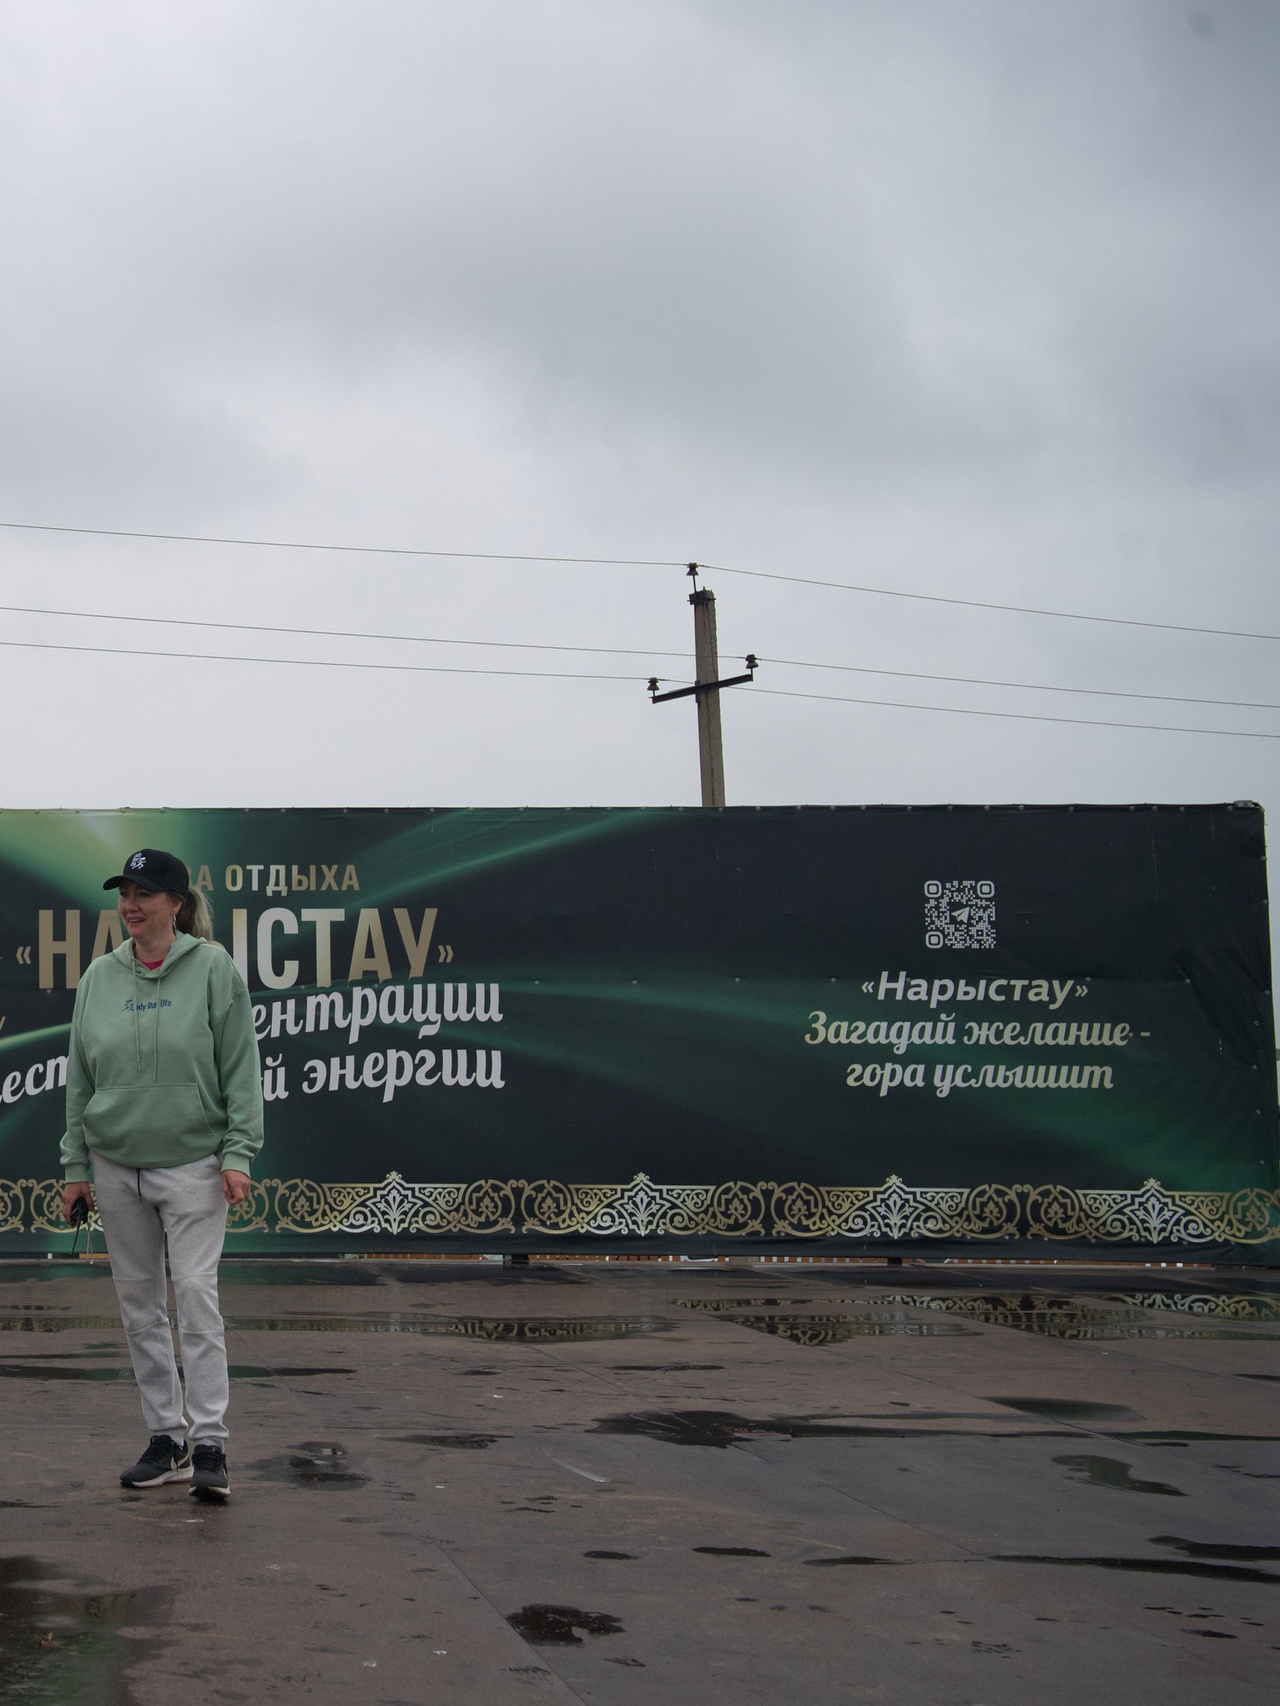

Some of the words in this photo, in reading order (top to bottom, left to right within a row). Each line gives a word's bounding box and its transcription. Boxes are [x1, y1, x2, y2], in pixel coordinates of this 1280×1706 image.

[225, 864, 360, 897] ОТДЫХА
[861, 970, 1089, 1010] «Нарыстау»
[252, 983, 503, 1044] ентрации
[804, 1010, 956, 1055] Загадай
[963, 1022, 1131, 1046] желание
[302, 1048, 505, 1104] энергии
[846, 1062, 925, 1097] гора
[932, 1063, 1114, 1098] услышит
